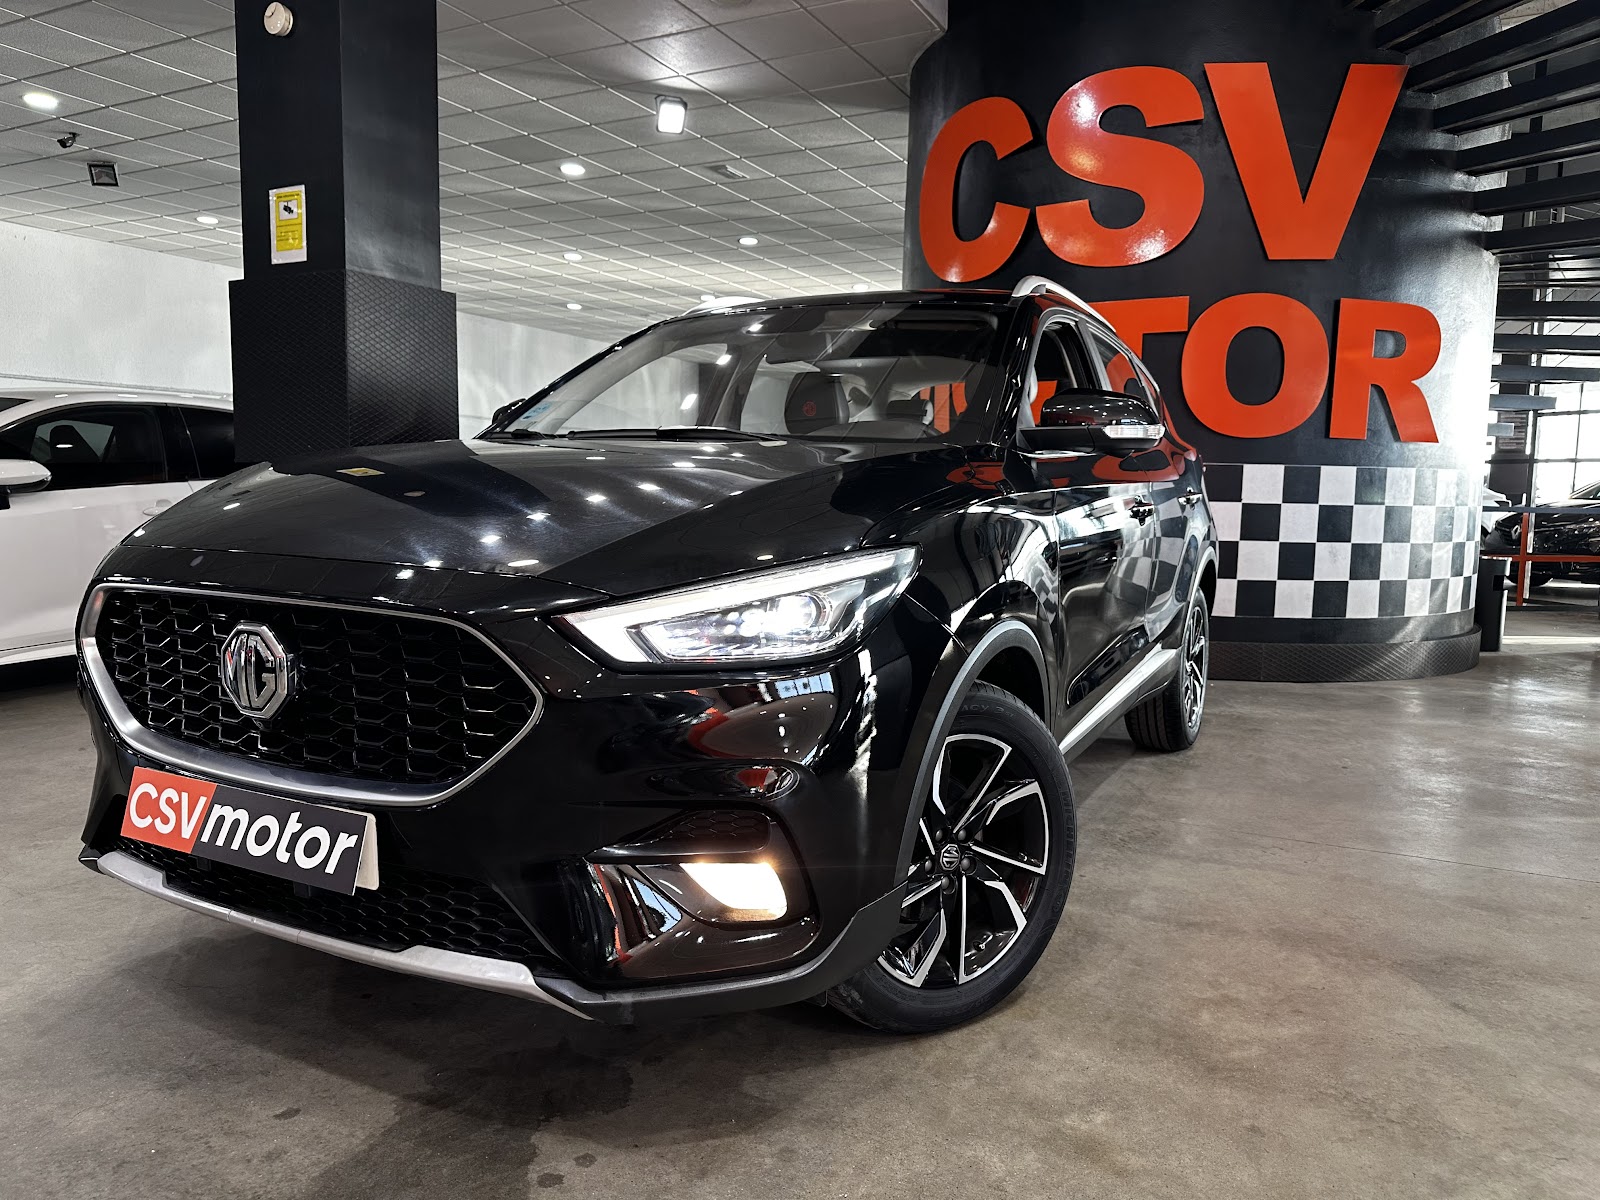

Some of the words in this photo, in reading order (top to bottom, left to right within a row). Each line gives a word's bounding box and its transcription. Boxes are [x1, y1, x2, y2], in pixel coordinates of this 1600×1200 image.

[919, 62, 1410, 283] CSV
[1083, 292, 1442, 443] TOR
[223, 630, 278, 711] MG
